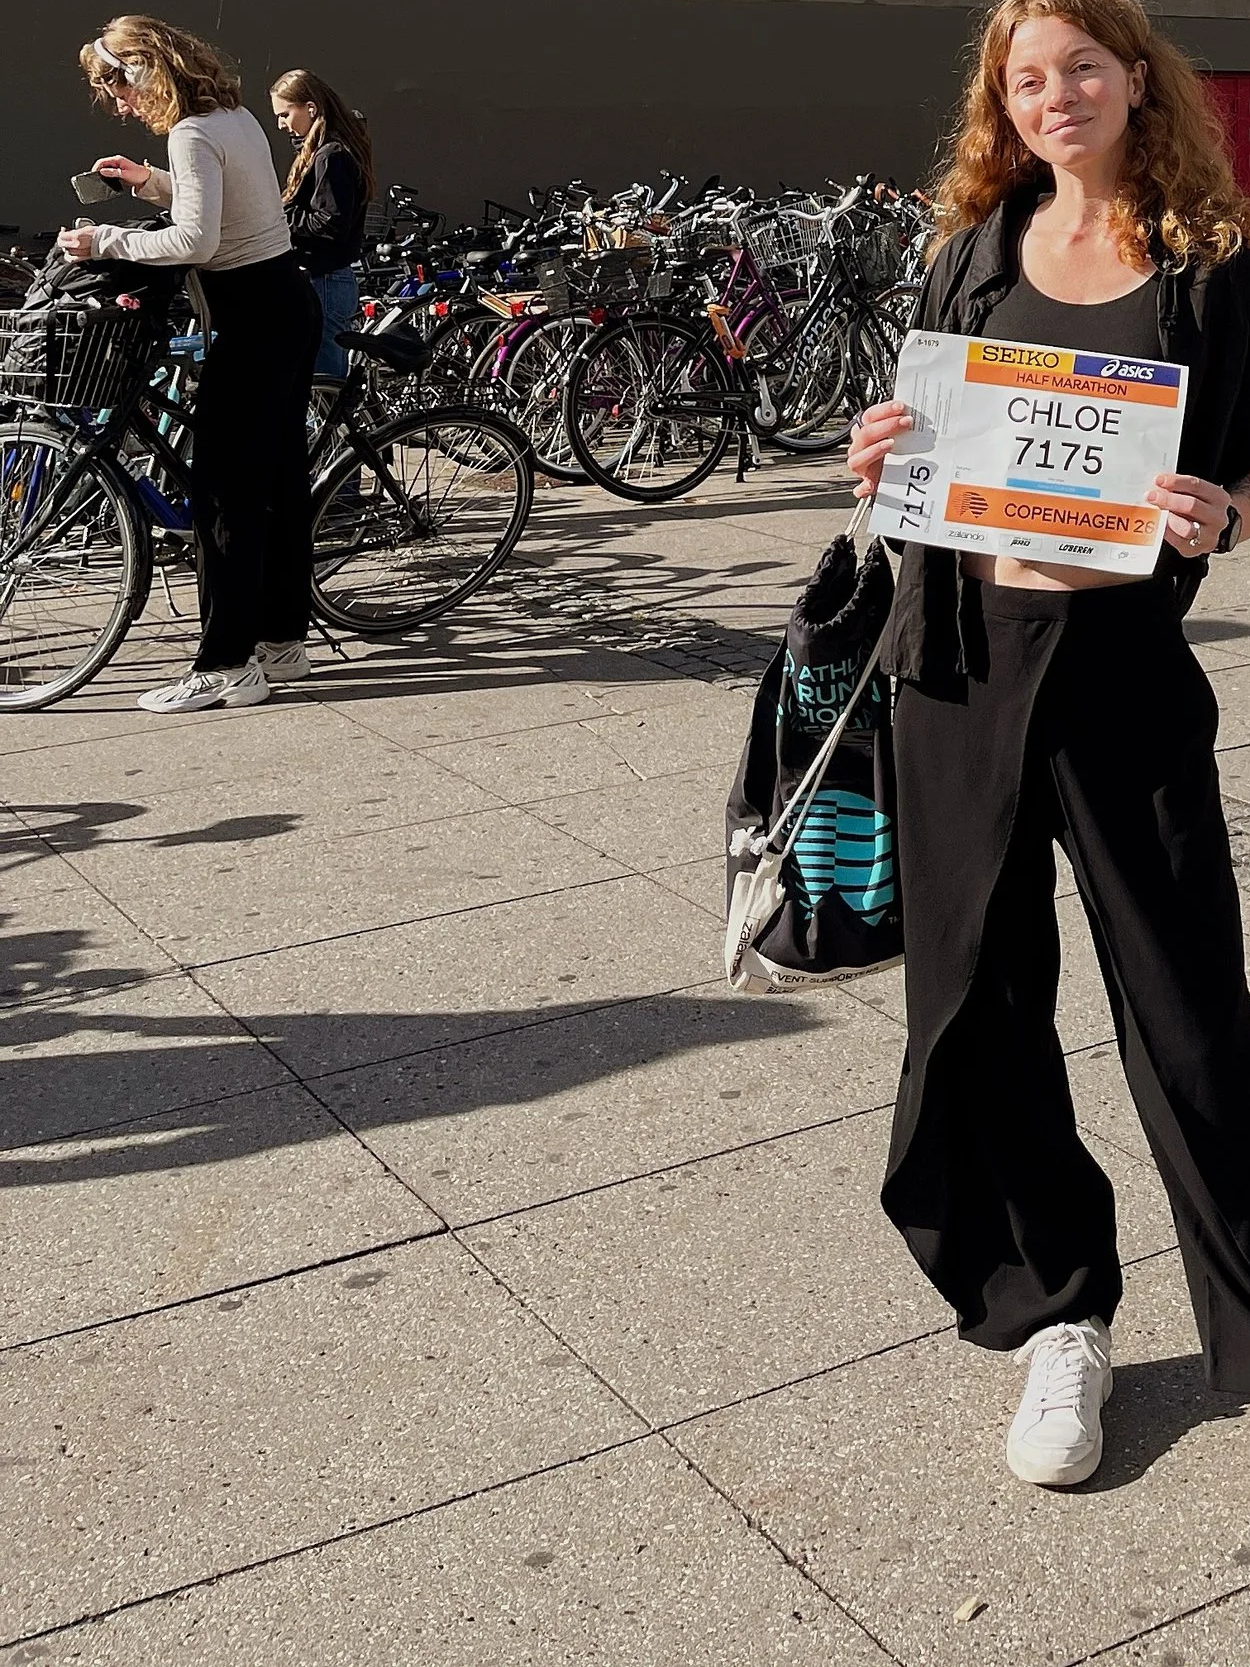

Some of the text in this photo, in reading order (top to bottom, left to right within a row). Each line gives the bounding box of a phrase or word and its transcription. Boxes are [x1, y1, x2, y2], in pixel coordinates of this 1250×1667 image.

[982, 345, 1060, 369] SEIKO
[1016, 371, 1128, 396] HALF MARATHON
[1119, 363, 1154, 380] asics
[1007, 396, 1122, 435] CHLOE
[1015, 435, 1104, 475] 7175
[899, 465, 930, 529] 7175
[1004, 502, 1156, 535] COPENHAGEN 26
[948, 530, 985, 541] zalando
[771, 970, 807, 983] EVENT
